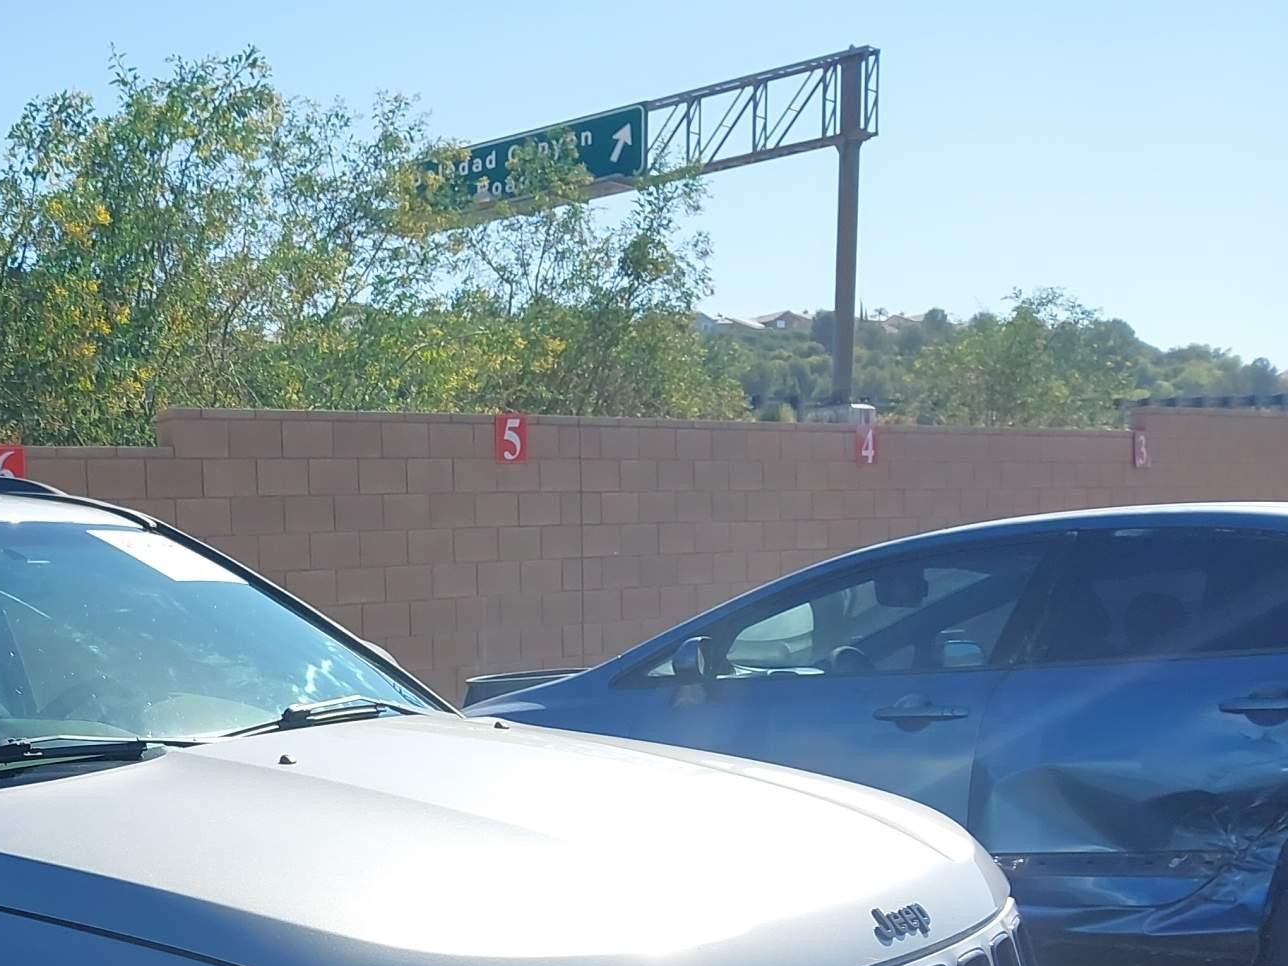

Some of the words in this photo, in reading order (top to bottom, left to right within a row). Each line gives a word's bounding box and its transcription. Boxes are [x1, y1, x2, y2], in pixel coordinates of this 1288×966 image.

[503, 418, 521, 460] 5
[861, 429, 875, 464] 4
[1137, 435, 1147, 465] 3
[871, 903, 931, 946] Jeep
